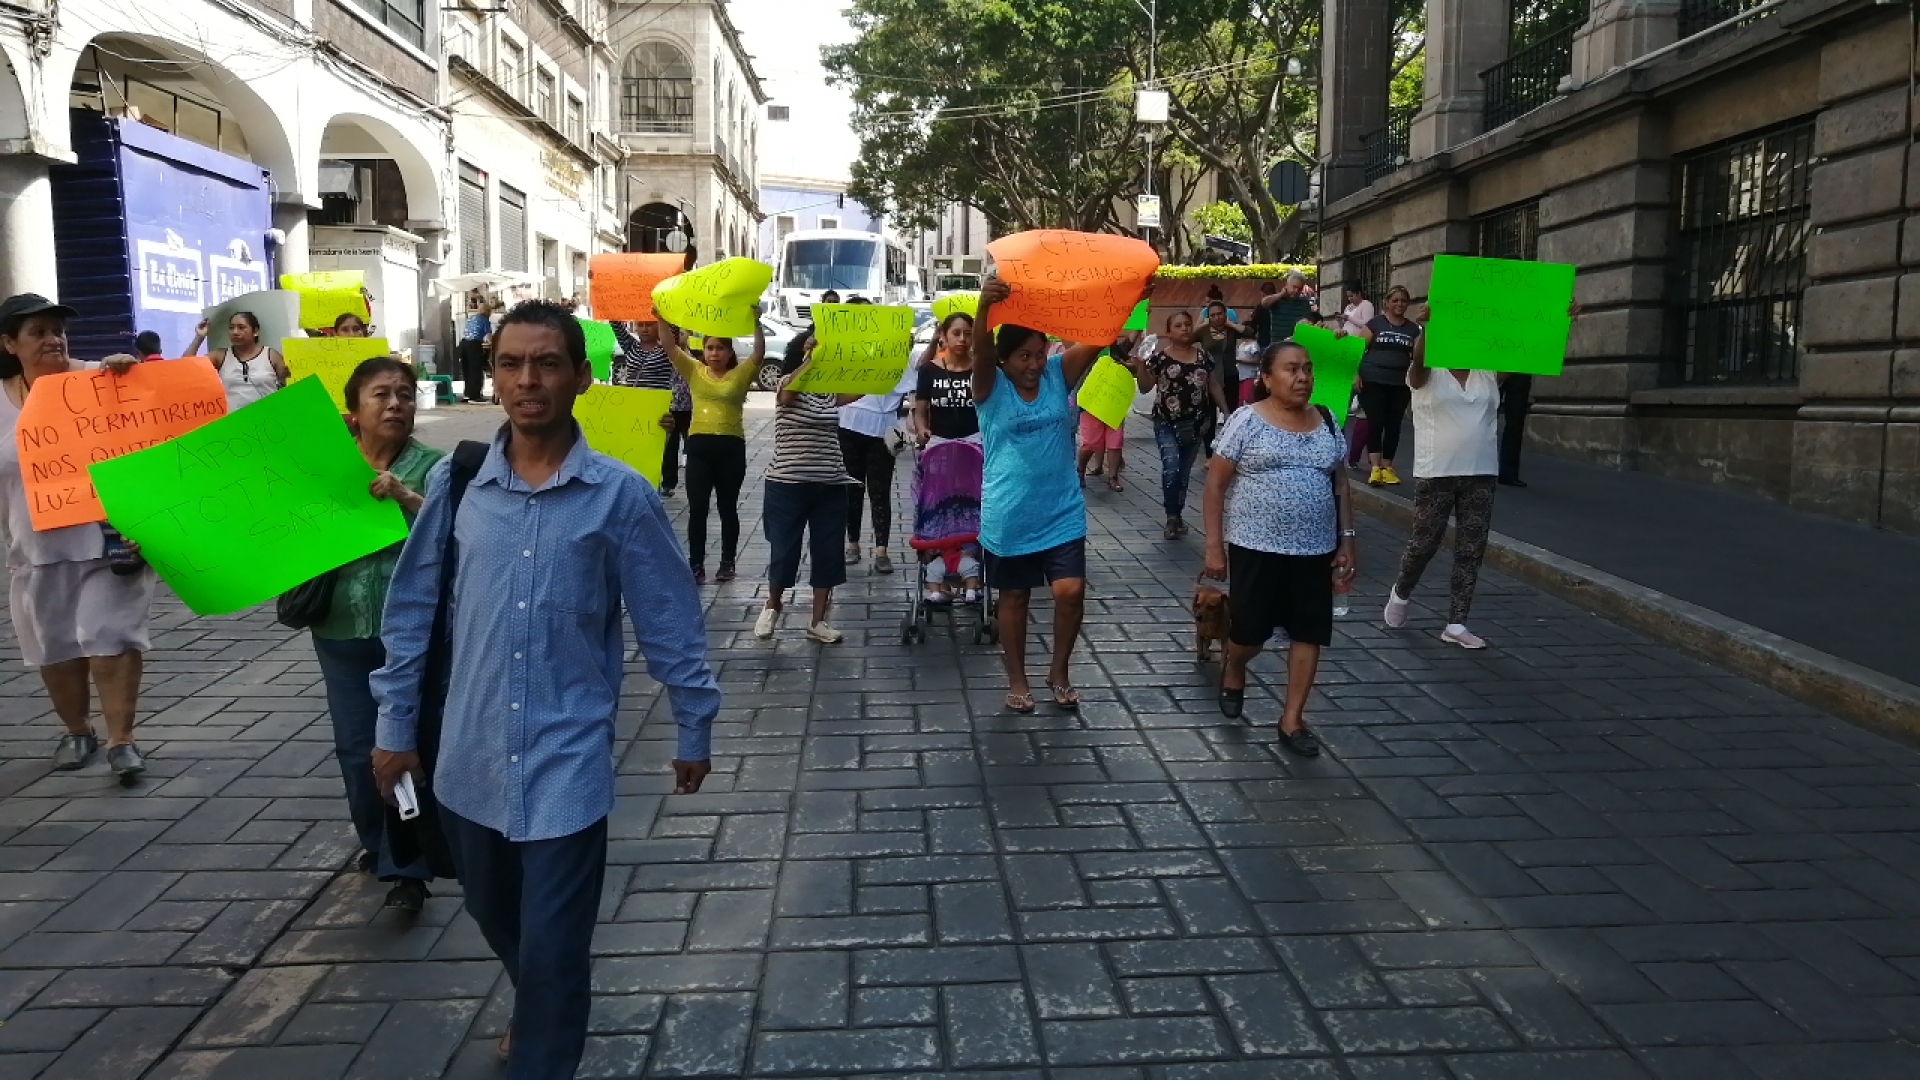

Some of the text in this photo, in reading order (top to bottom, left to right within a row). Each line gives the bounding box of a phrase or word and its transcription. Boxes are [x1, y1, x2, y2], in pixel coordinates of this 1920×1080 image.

[1000, 259, 1142, 284] TE EXIGIMOS
[1470, 261, 1541, 291] APOYO
[1010, 281, 1116, 304] RESPETO A
[684, 297, 734, 323] SAPAC
[821, 305, 909, 336] PATIOS DE
[999, 298, 1102, 320] NUESTROS
[1433, 300, 1561, 330] TOTAL AL
[820, 341, 844, 362] LA
[799, 366, 827, 381] EN
[62, 375, 140, 415] CFE
[21, 397, 225, 452] NO PERMITIREMOS
[631, 417, 659, 437] AL
[174, 416, 288, 481] APOYO
[31, 454, 78, 483] NOS
[33, 487, 80, 515] LUZ
[127, 454, 320, 537] TOTAL
[158, 552, 220, 582] AL
